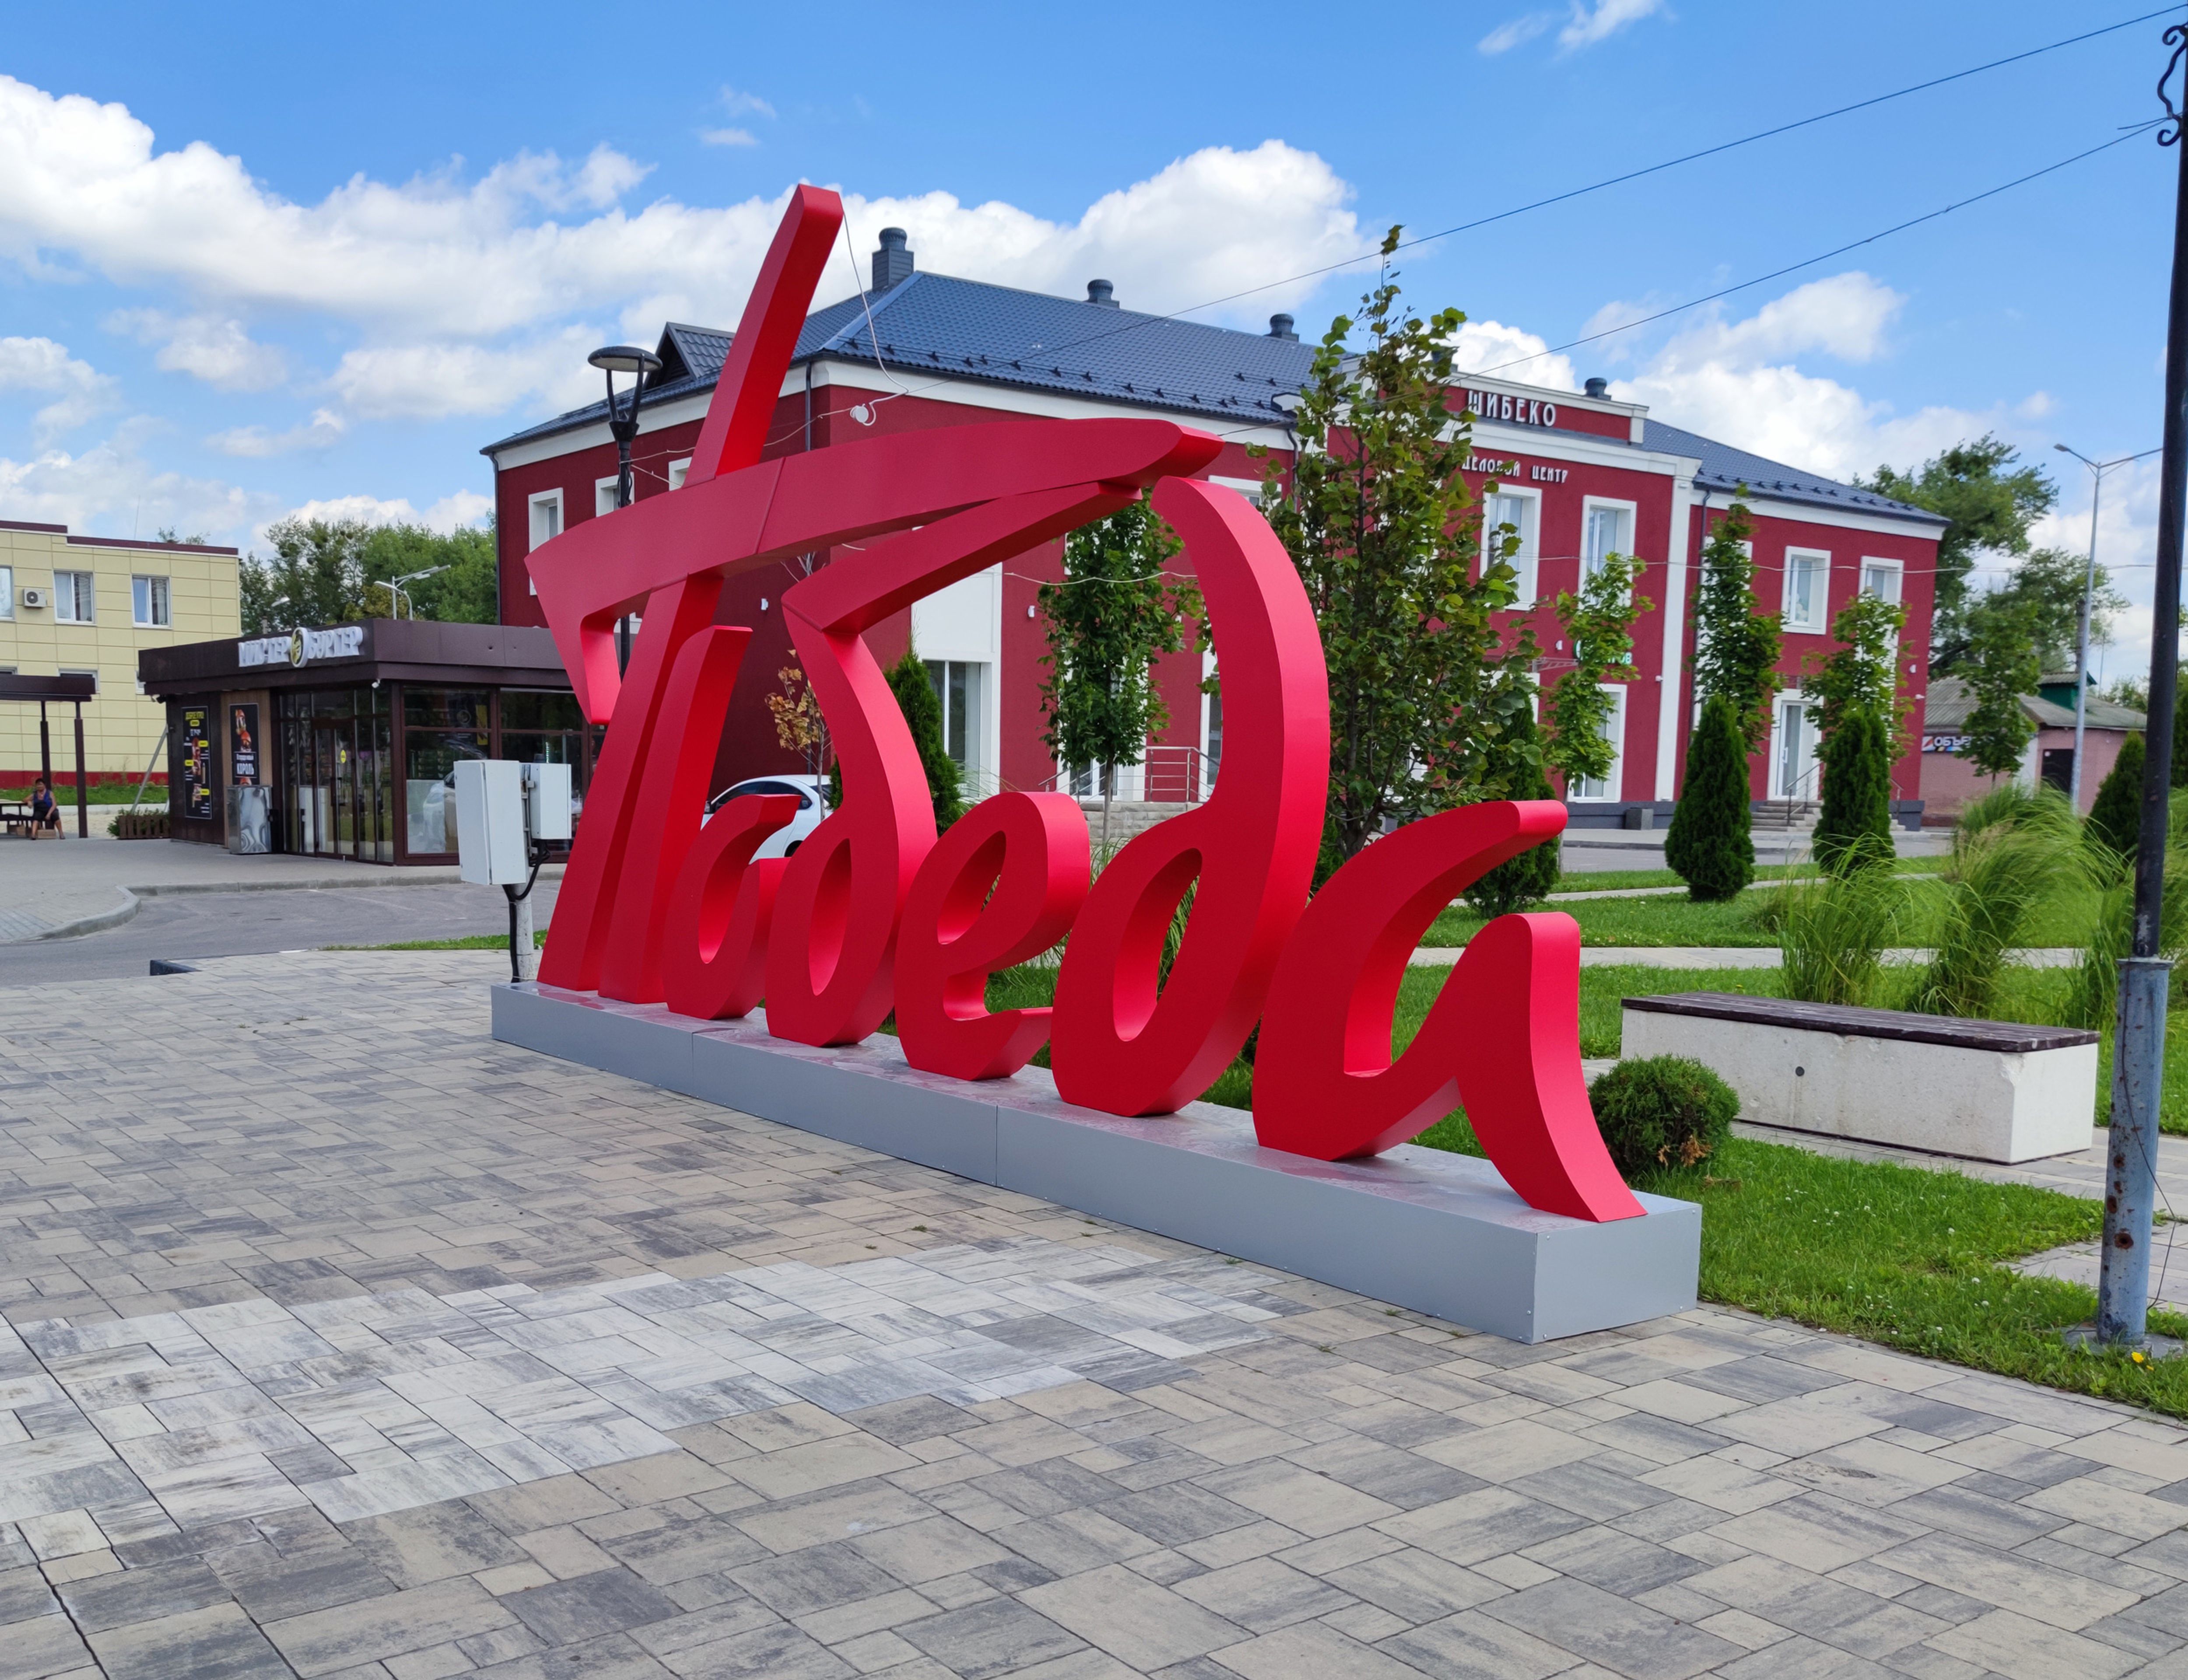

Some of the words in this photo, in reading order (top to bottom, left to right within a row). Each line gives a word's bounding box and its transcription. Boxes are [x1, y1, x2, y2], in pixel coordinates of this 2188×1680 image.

[1468, 390, 1556, 427] ШИБЕКО
[1532, 465, 1568, 483] ЦЕНТР
[526, 184, 1647, 1222] Победа
